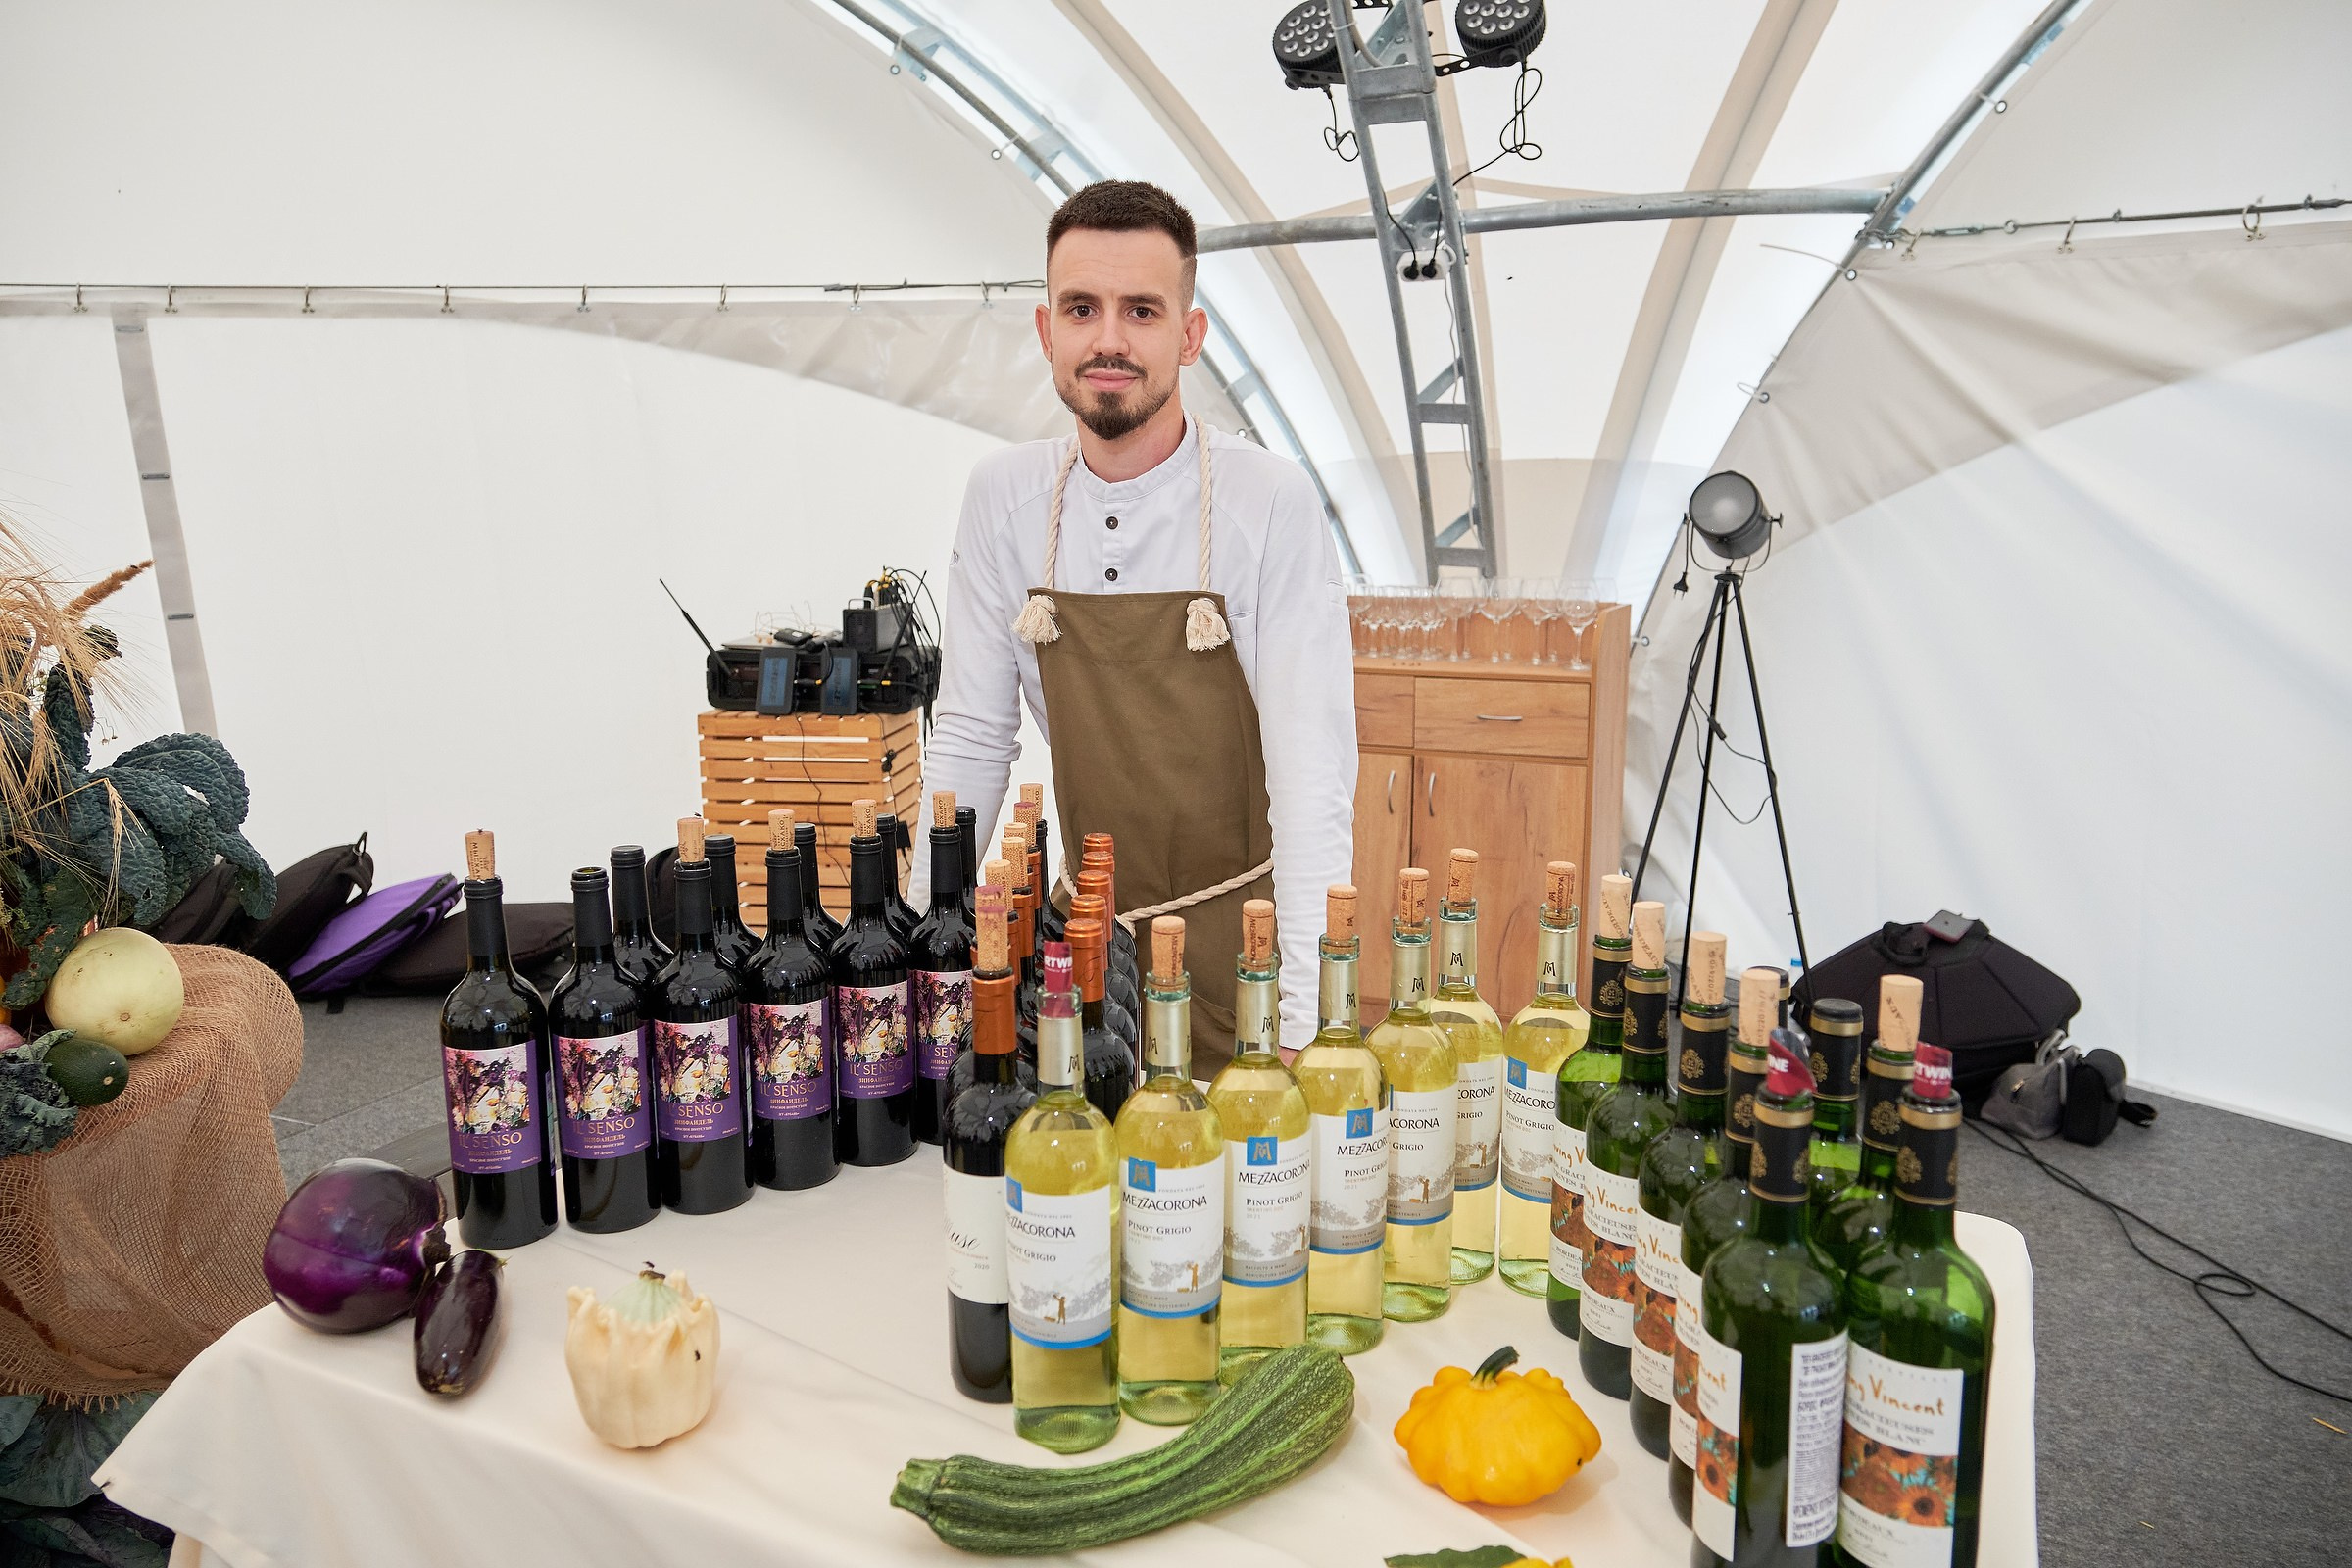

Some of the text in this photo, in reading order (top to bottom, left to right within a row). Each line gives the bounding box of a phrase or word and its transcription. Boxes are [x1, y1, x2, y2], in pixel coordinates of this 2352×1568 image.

[863, 1059, 903, 1075] SENSO
[773, 1081, 816, 1097] SENSO
[678, 1102, 724, 1118] SENSO
[588, 1116, 635, 1135] SENSO
[1525, 1119, 1555, 1131] GRIGIO
[472, 1131, 522, 1149] SENSO
[1392, 1142, 1424, 1151] GRIGIO
[1345, 1168, 1370, 1177] PINOT
[1122, 1191, 1207, 1211] MEZZACORONA
[1246, 1198, 1275, 1206] PINOT
[1128, 1219, 1192, 1236] PINOT GRIGIO
[1024, 1250, 1056, 1262] GRIGIO
[1869, 1374, 1944, 1416] Vincent
